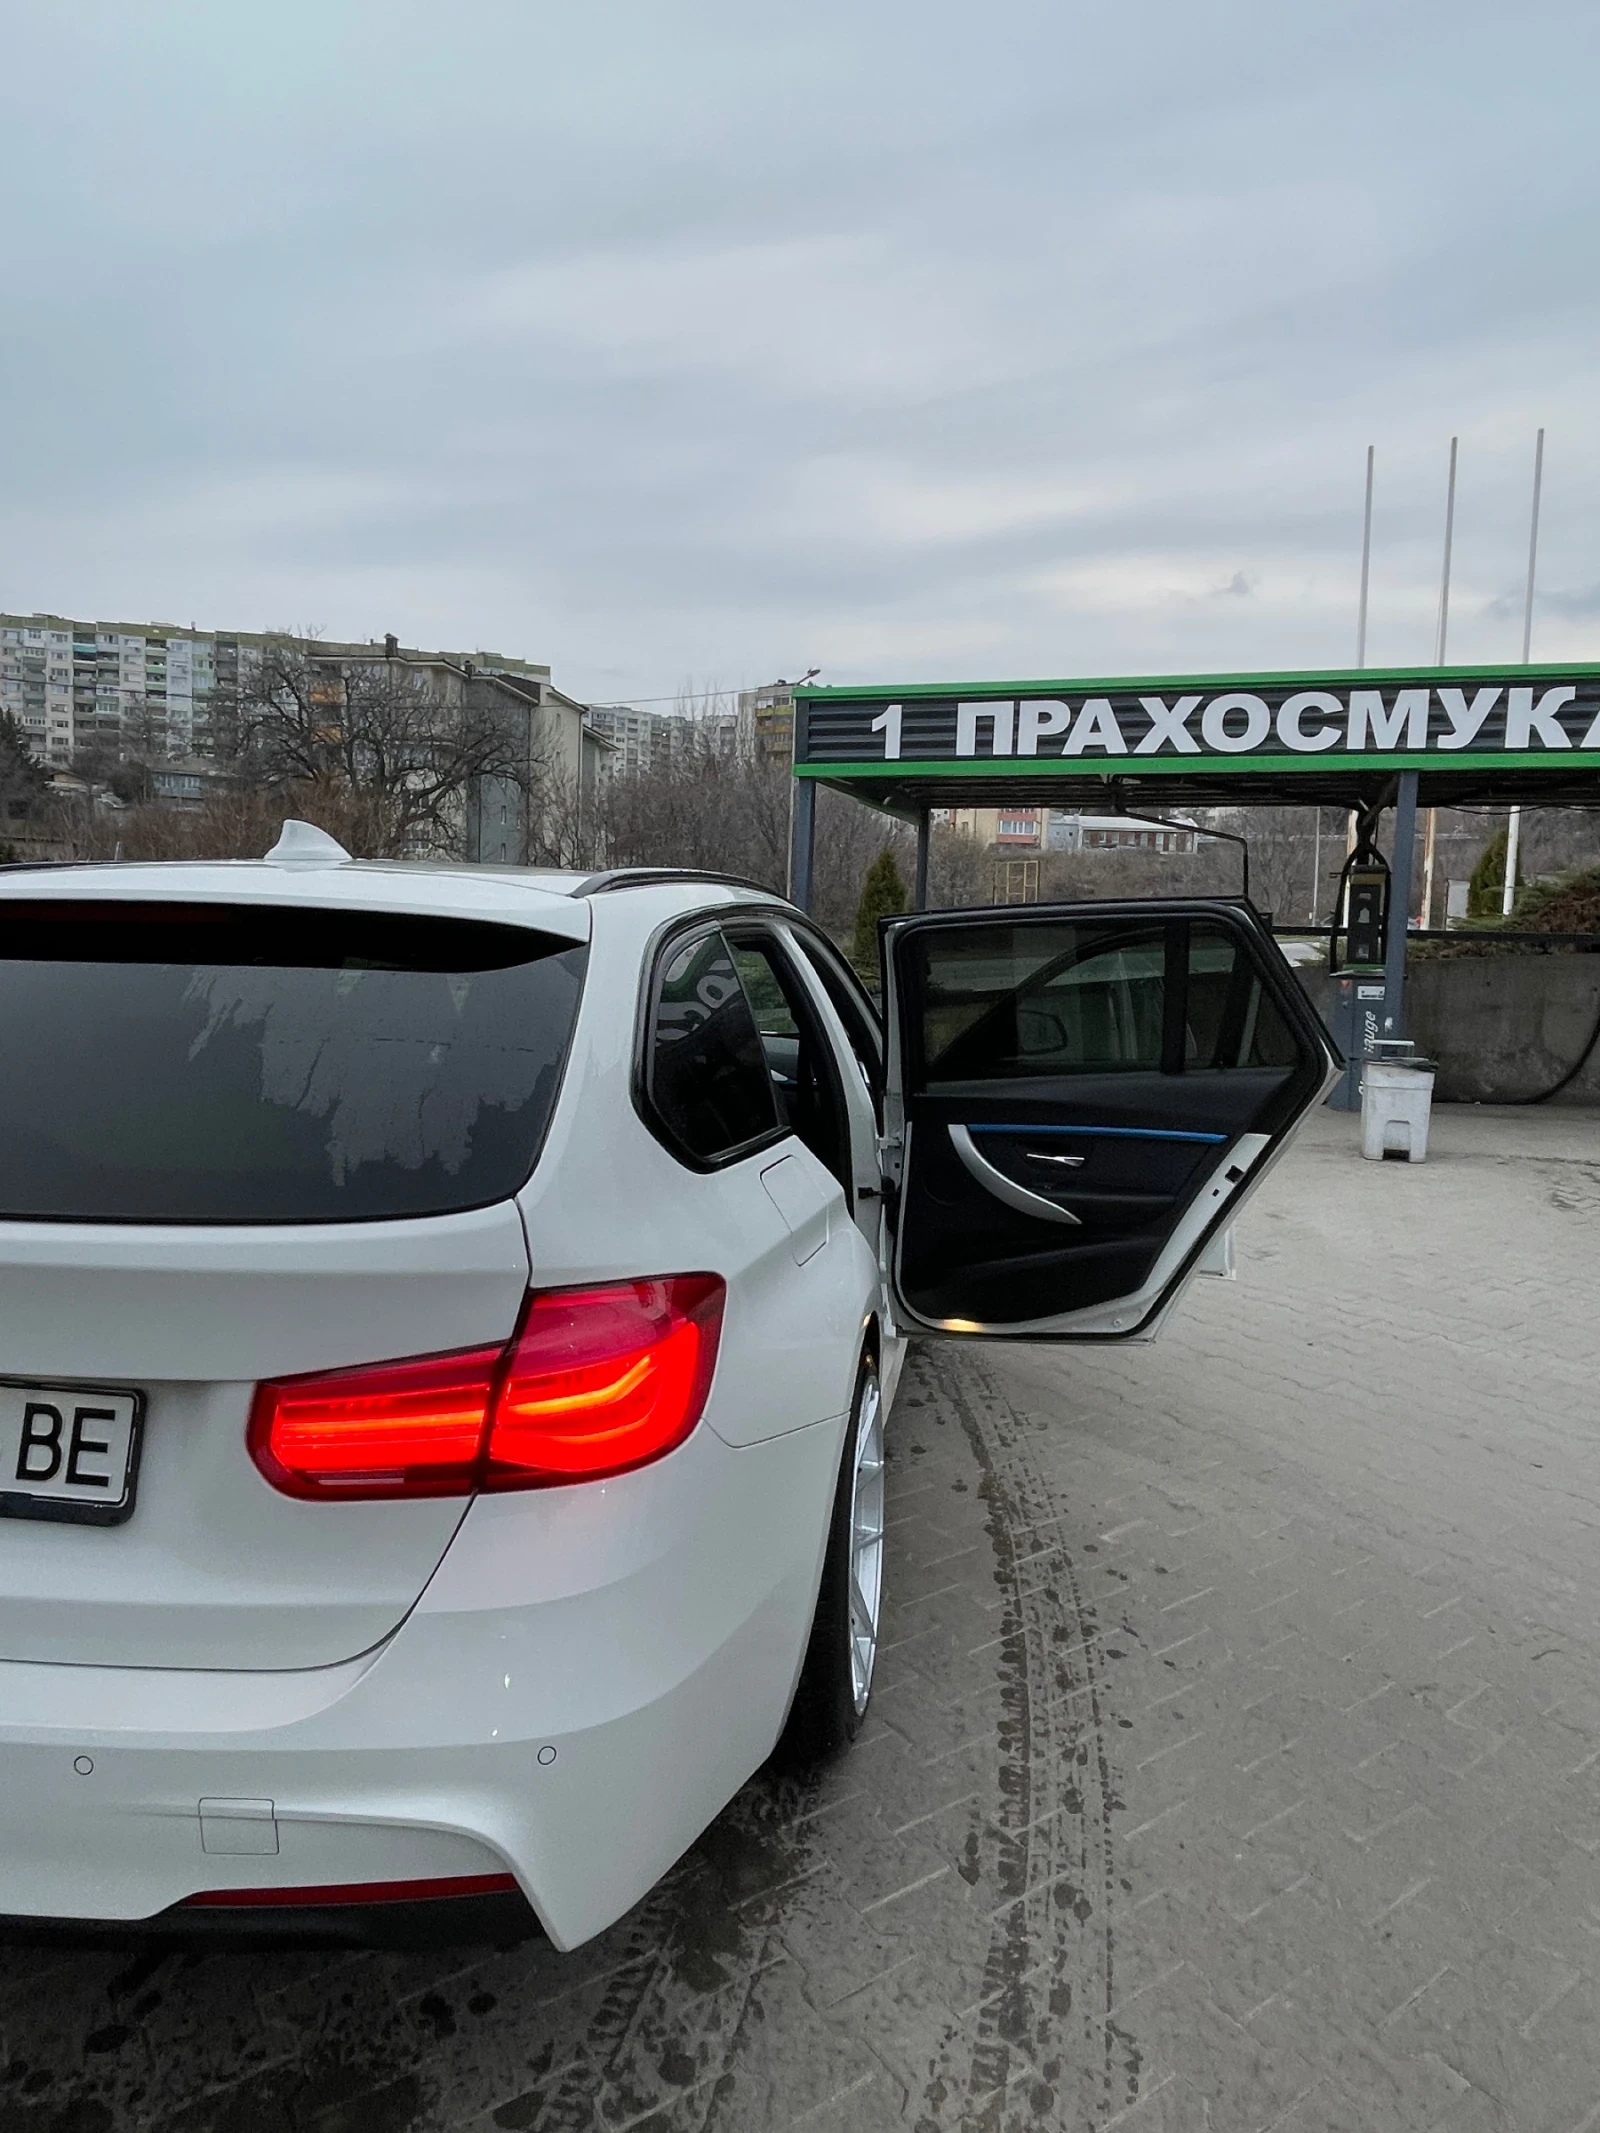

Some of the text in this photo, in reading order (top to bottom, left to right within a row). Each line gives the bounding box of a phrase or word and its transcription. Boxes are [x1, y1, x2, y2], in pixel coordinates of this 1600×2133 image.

[871, 686, 1600, 759] 1 ПРАХОСМУК
[15, 1402, 116, 1487] BE
